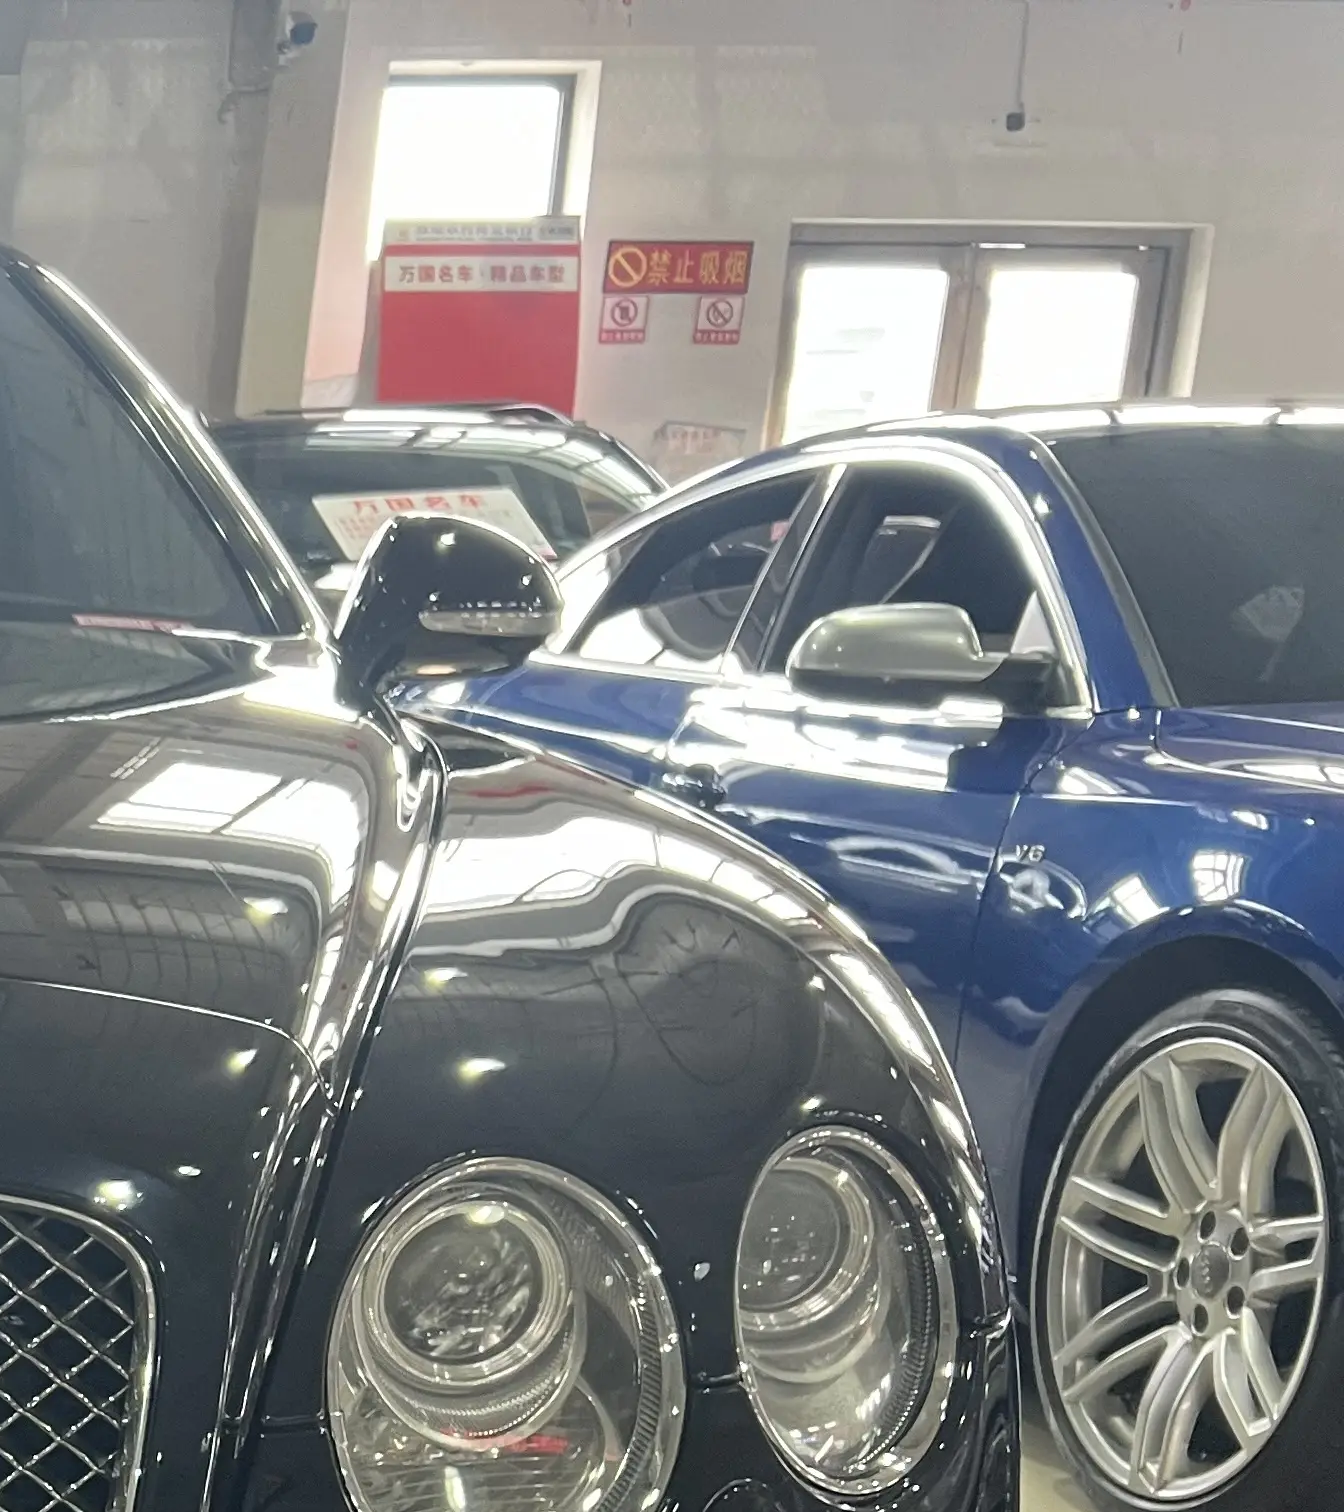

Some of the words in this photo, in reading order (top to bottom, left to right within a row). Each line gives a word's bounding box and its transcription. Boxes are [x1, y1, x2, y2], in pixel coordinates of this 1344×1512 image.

[647, 248, 748, 286] 禁止吸烟
[1015, 844, 1045, 862] V6
